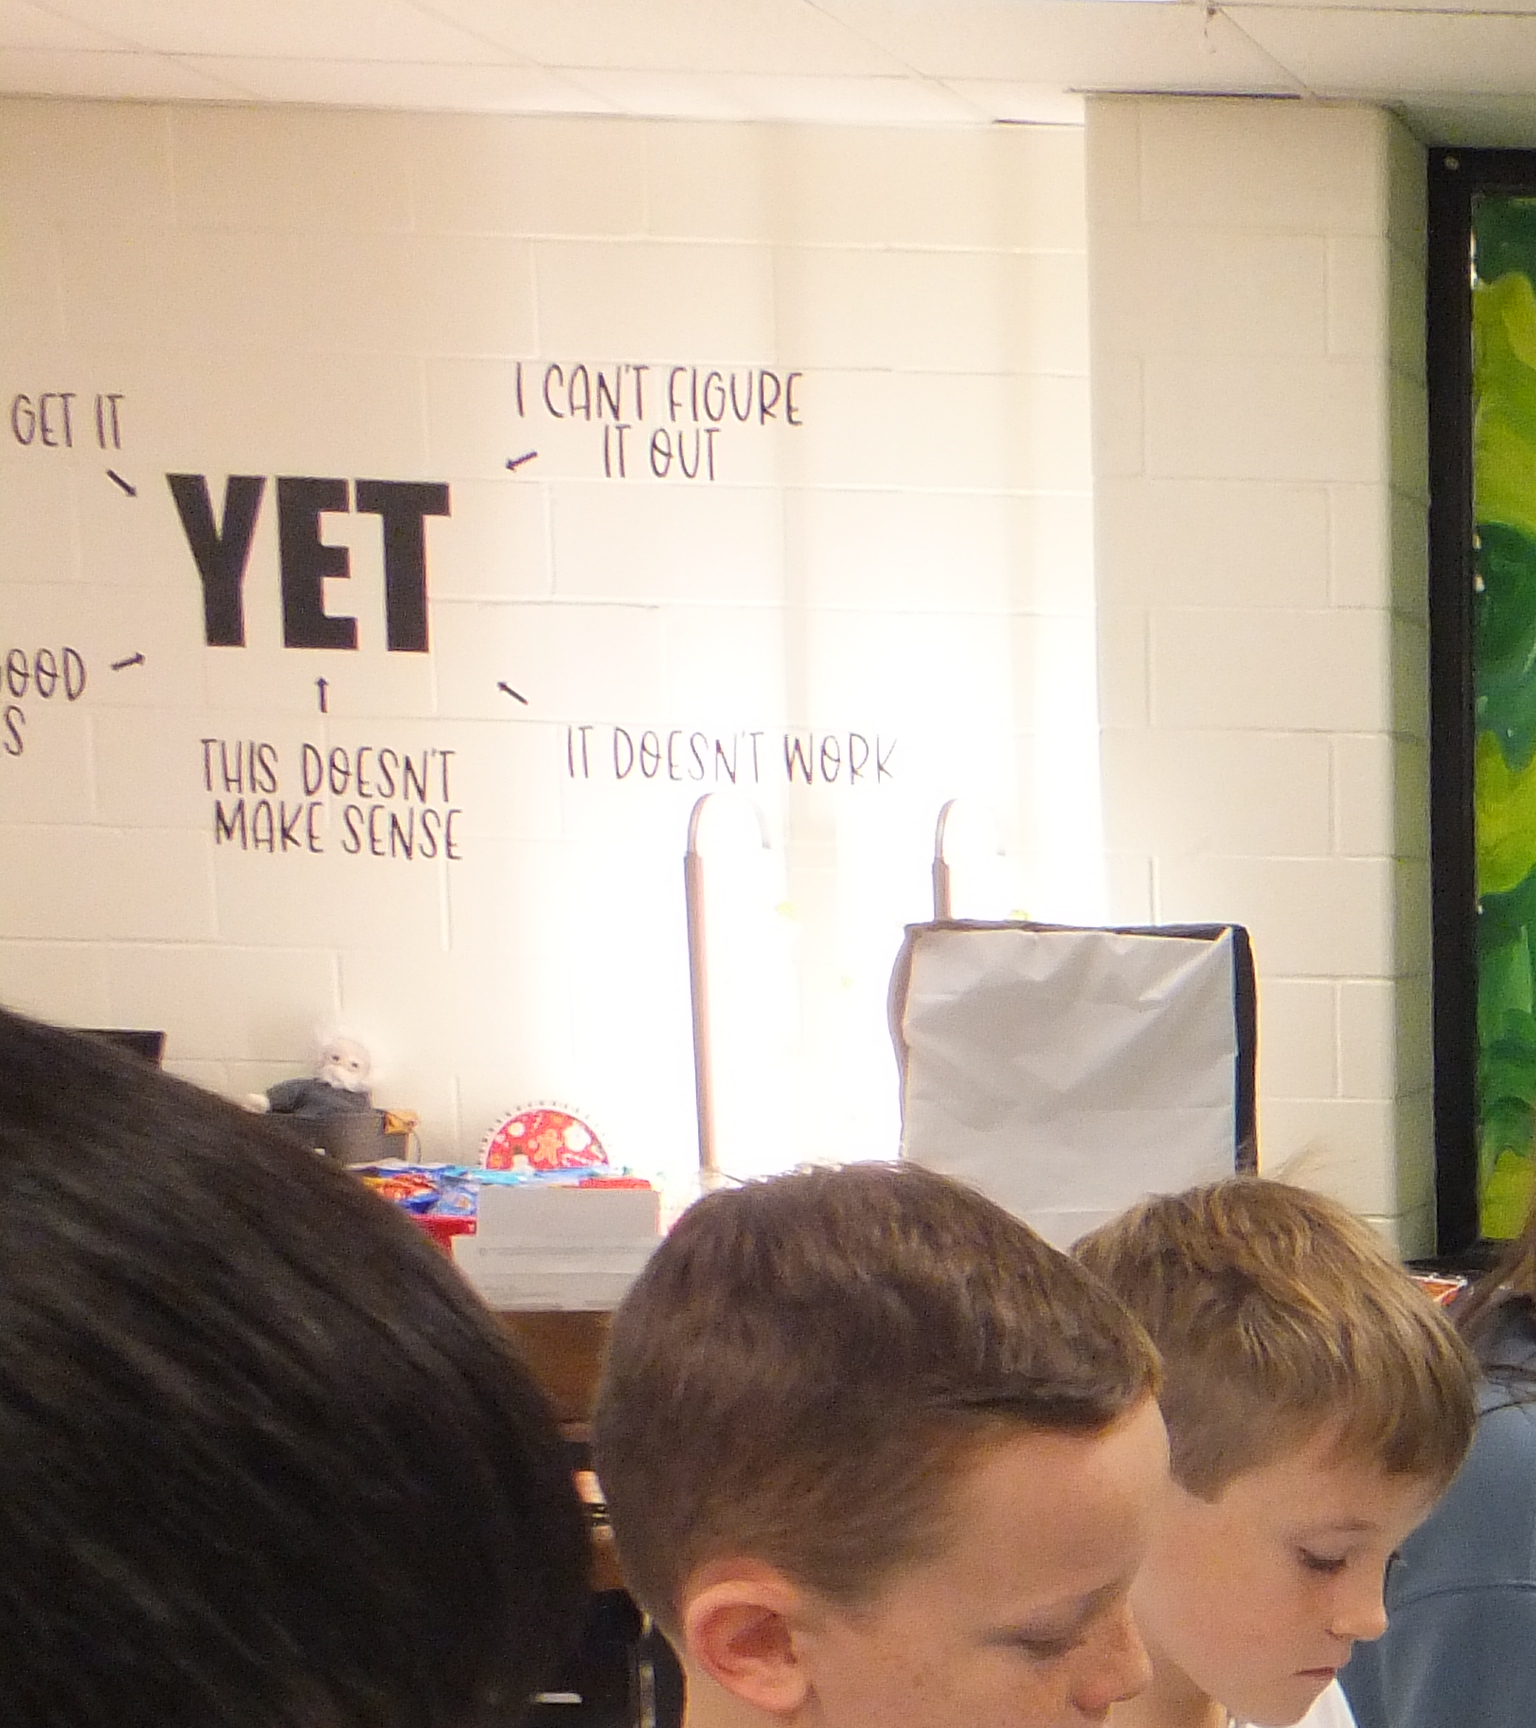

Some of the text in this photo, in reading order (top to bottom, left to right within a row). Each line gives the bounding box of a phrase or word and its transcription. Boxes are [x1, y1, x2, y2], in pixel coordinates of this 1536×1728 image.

[10, 392, 125, 450] GET IT
[515, 361, 803, 426] I CAN'T FIGURE
[604, 424, 721, 481] IT OUT
[166, 473, 452, 653] YET
[0, 646, 87, 702] OOD
[201, 738, 456, 804] THIS DOESN'T
[566, 725, 897, 785] IT DOESN'T WORK
[215, 797, 463, 861] MAKE SENSE
